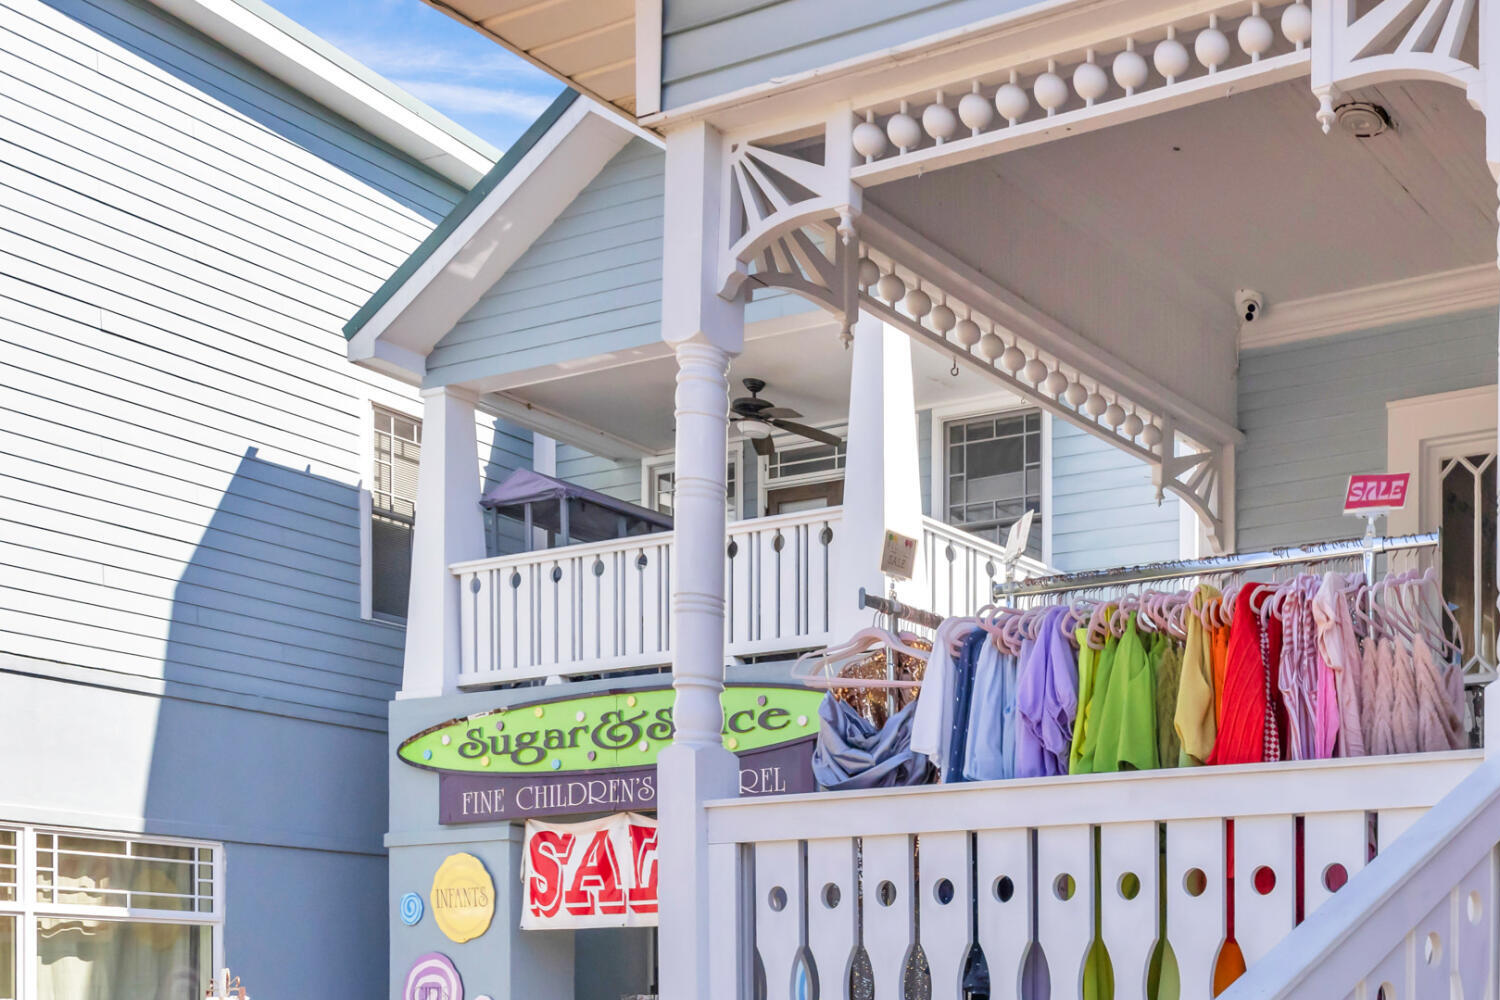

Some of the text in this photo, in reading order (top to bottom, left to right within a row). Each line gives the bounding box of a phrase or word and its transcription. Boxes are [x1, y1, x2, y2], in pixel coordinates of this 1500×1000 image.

[1348, 480, 1405, 502] SALE
[461, 776, 656, 816] FINE CHILDREN'S
[529, 824, 659, 919] SAL
[436, 886, 489, 909] INFANTS
